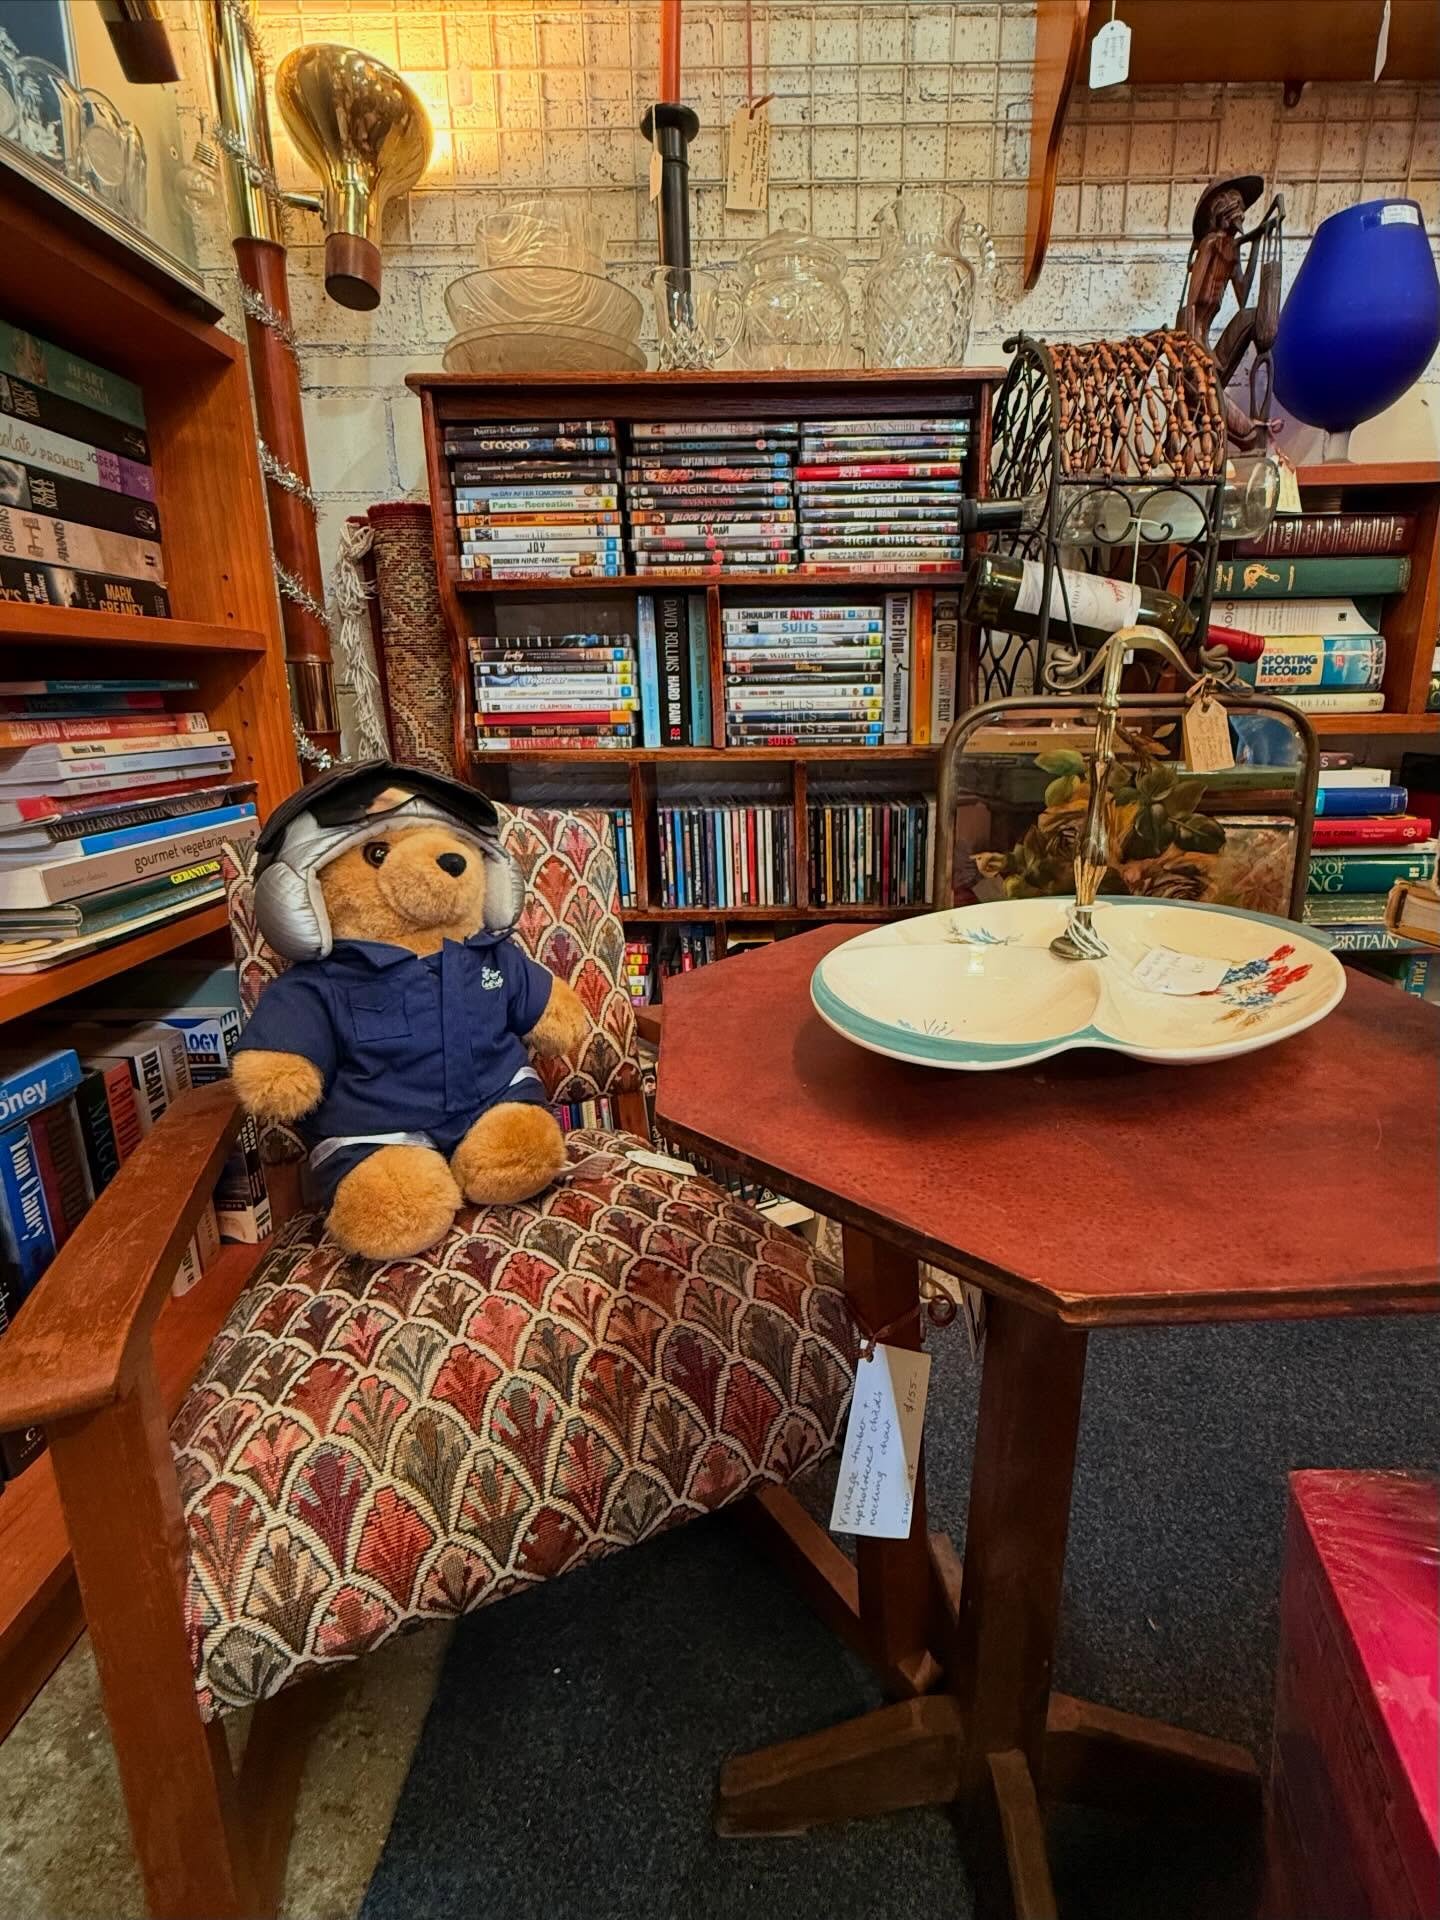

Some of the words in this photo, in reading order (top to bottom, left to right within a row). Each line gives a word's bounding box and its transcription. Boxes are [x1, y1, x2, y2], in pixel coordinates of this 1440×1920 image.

[888, 421, 915, 432] Smith
[480, 439, 530, 453] eragon
[662, 485, 708, 495] MARGIN
[712, 483, 745, 494] CALL
[852, 481, 903, 491] HANCOCK
[492, 501, 517, 509] Parks
[525, 500, 574, 509] Recreation
[671, 513, 700, 523] BLOOD
[701, 513, 715, 522] ON
[716, 512, 733, 522] THE
[0, 507, 17, 554] GIBBINS
[51, 520, 70, 563] ATLANTIS
[527, 542, 546, 553] JOY
[844, 536, 872, 546] HIGH
[875, 535, 916, 545] CRIMES
[521, 556, 560, 564] NINE-NINE
[104, 583, 135, 604] MARK
[99, 600, 144, 616] GREANEY
[664, 599, 678, 629] DAVID
[742, 610, 780, 620] SHOULDN'T
[789, 610, 816, 620] ALIVE
[891, 596, 908, 627] Vince
[781, 622, 818, 632] SUITS
[889, 627, 907, 657] Flynn
[937, 623, 956, 652] CONTEST
[665, 628, 680, 673] ROLLINS
[769, 650, 821, 660] waterwise
[1261, 654, 1318, 667] SPORTING
[513, 664, 543, 673] Clarkson
[1260, 664, 1313, 676] RECORDS
[667, 674, 682, 701] HARD
[540, 702, 573, 711] CLARKSON
[780, 699, 815, 710] HILLS
[937, 695, 951, 723] REILLY
[668, 702, 681, 726] RAIN
[784, 711, 817, 722] HILLS
[8, 721, 61, 742] GANGLAND
[62, 718, 112, 740] Queensland
[777, 722, 816, 734] HILLS
[768, 735, 796, 746] SUITS
[50, 819, 87, 840] WILD
[87, 808, 131, 833] HARVEST
[131, 803, 162, 824] WITH
[134, 846, 181, 874] gourmet
[181, 833, 230, 858] vegetarian
[1325, 860, 1345, 875] OF
[1334, 934, 1399, 950] BRITAIN
[1415, 961, 1428, 988] PAUL
[141, 1052, 163, 1099] DEAN
[9, 1131, 32, 1179] Tom
[19, 1179, 47, 1241] Clancy
[837, 1469, 860, 1527] Vintage
